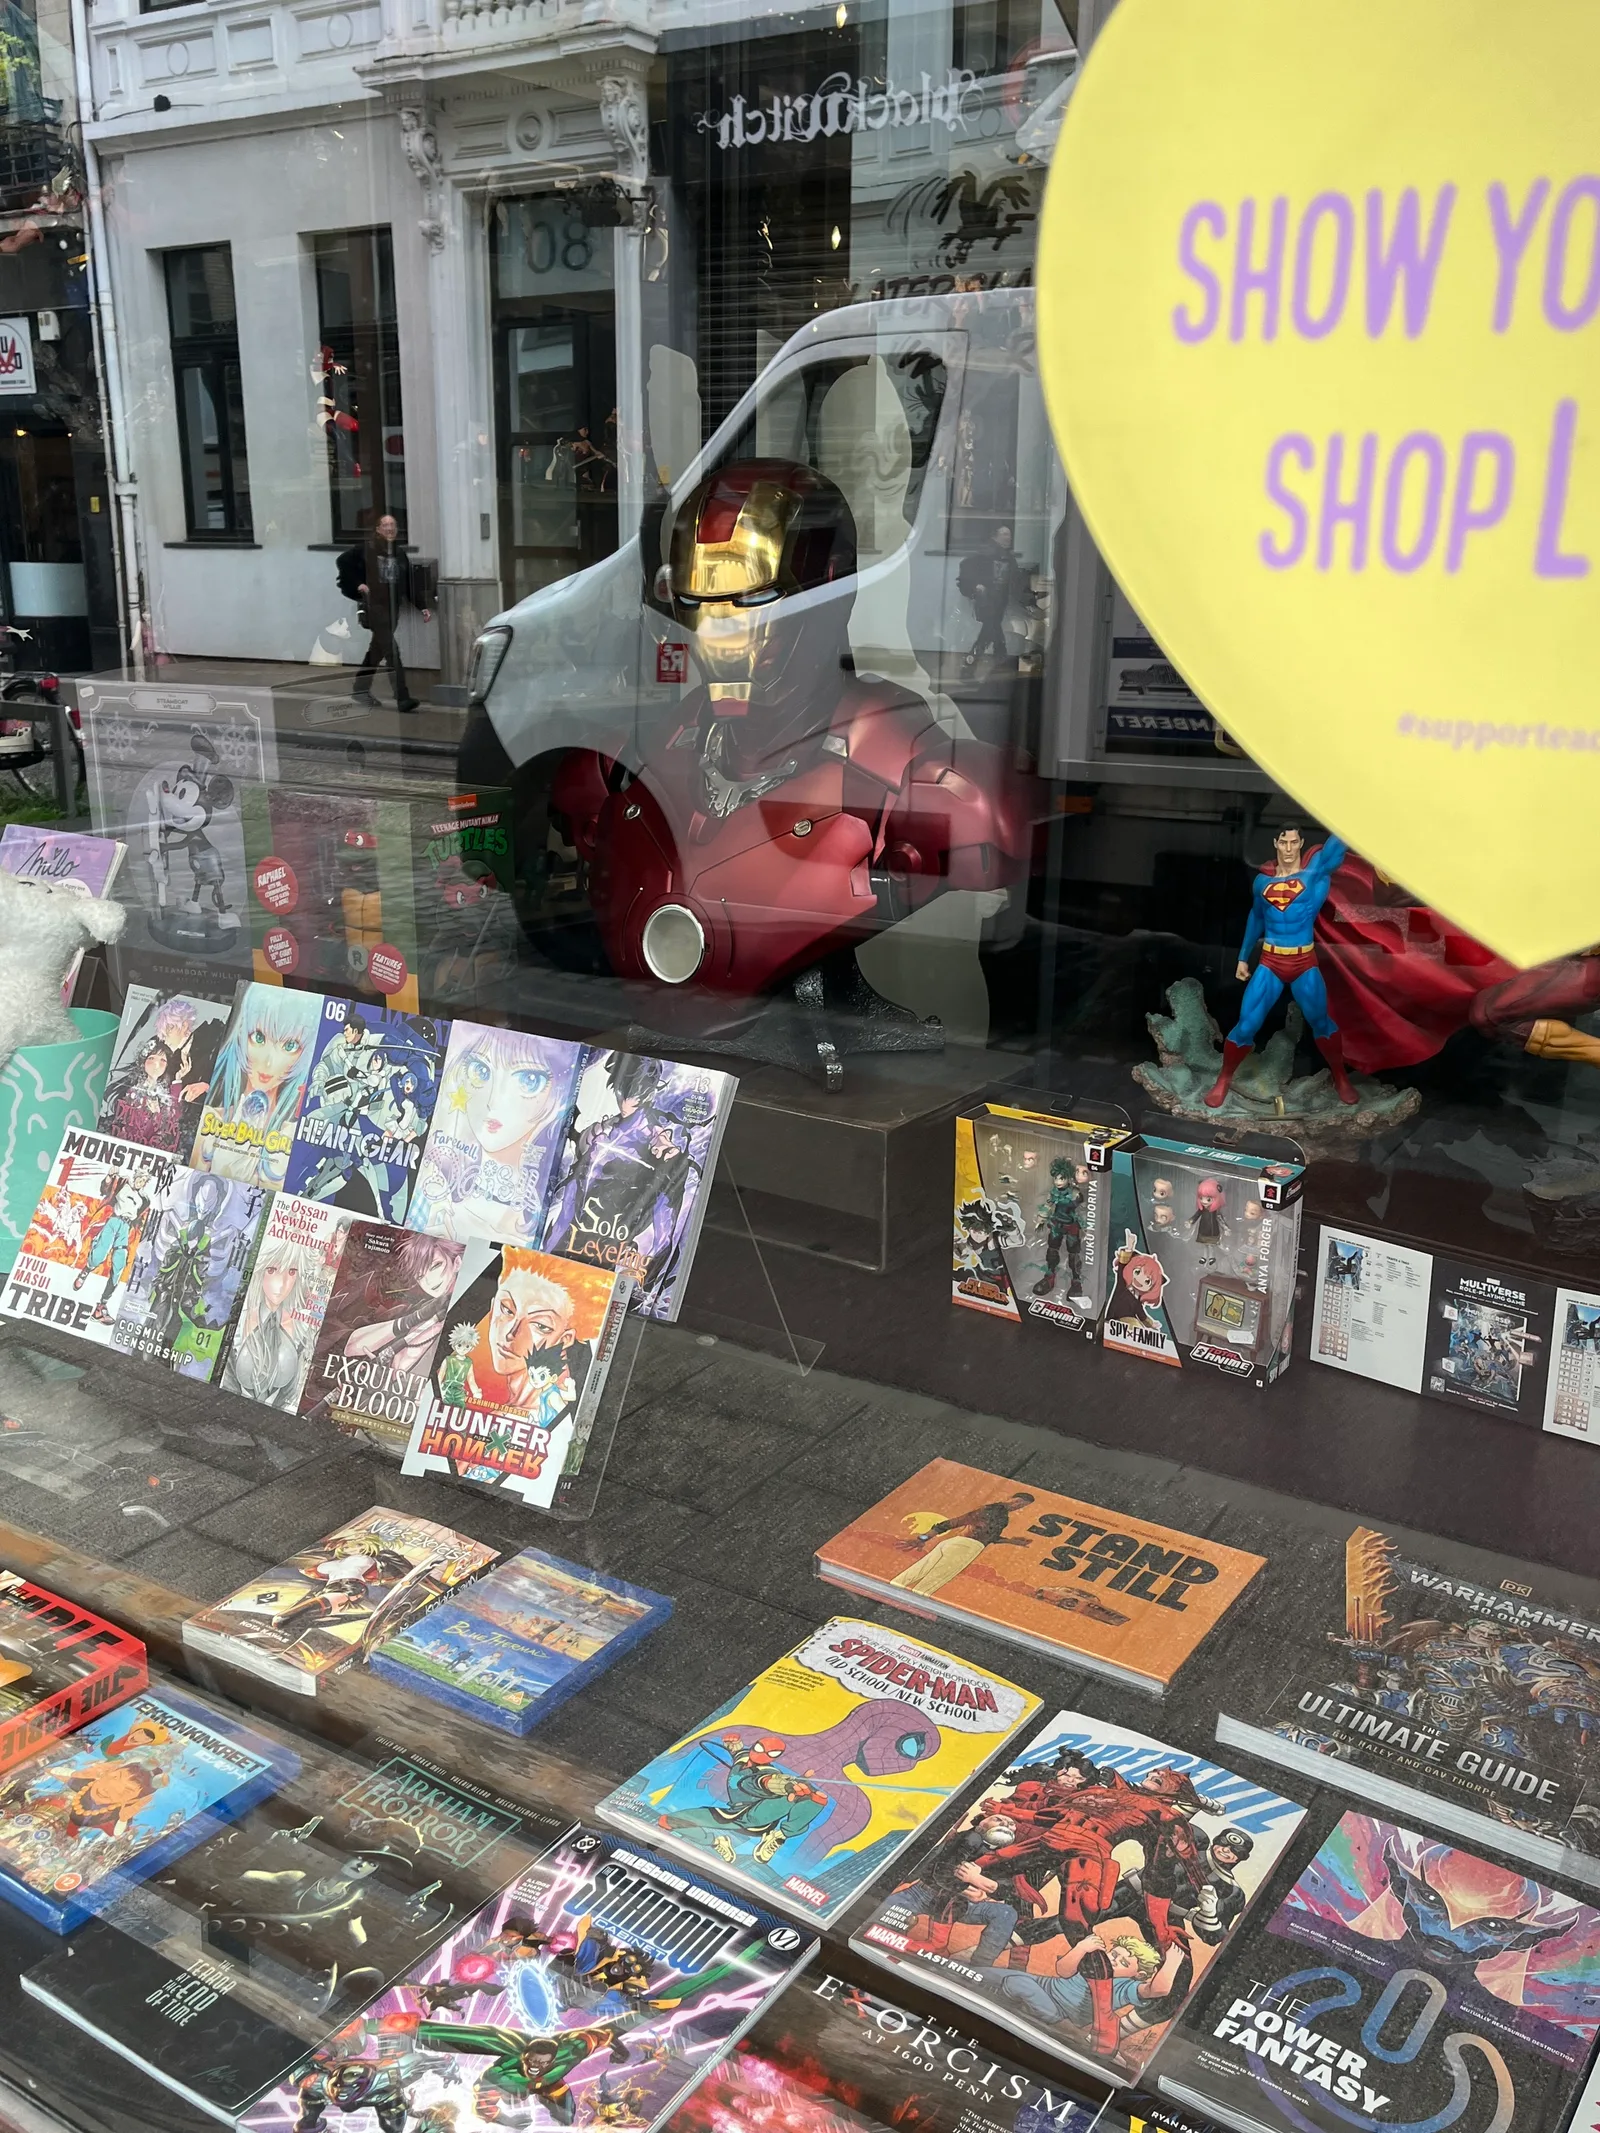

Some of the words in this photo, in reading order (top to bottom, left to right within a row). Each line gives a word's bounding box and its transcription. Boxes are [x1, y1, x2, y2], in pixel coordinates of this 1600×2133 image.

[1172, 181, 1457, 345] SHOW
[1486, 174, 1600, 335] YO
[1258, 431, 1515, 574] SHOP
[1533, 396, 1591, 578] L
[431, 820, 460, 834] TEENAGE
[459, 817, 482, 829] MUTANT
[420, 827, 509, 871] TURTLES
[257, 866, 287, 888] RAPHAEL
[372, 952, 402, 970] FEATURES
[325, 1000, 347, 1022] 06
[692, 1077, 711, 1094] 13
[201, 1113, 237, 1142] SUPER
[235, 1121, 265, 1148] BALL
[296, 1116, 361, 1154] HEART
[360, 1132, 421, 1170] GEAR
[432, 1129, 479, 1161] Farewell,
[57, 1155, 76, 1187] 1
[62, 1131, 168, 1178] MONSTER
[1185, 1146, 1206, 1156] SPY
[1208, 1148, 1245, 1162] FAMILY
[271, 1209, 319, 1234] Newbie
[276, 1199, 291, 1212] The
[290, 1199, 329, 1222] Ossan
[574, 1196, 630, 1242] Solo
[1086, 1180, 1098, 1232] MIDORIYA
[364, 1243, 391, 1254] Fujimoto
[367, 1238, 390, 1248] Sakura
[567, 1222, 653, 1280] Leveling
[1084, 1233, 1096, 1265] IZUKU
[1260, 1218, 1274, 1257] FORGER
[13, 1269, 51, 1290] MASUI
[18, 1255, 48, 1276] JYUU
[1257, 1260, 1270, 1294] ANYA
[1459, 1285, 1505, 1302] ROLE-PLAYING
[1505, 1297, 1526, 1307] GAME
[1460, 1277, 1526, 1301] MULTIVERSE
[7, 1284, 94, 1332] TRIBE
[1041, 1308, 1082, 1325] ANIME
[118, 1319, 165, 1344] COSMIC
[195, 1331, 212, 1350] 01
[602, 1301, 627, 1363] HUNTER
[114, 1332, 193, 1366] CENSORSHIP
[1204, 1353, 1250, 1371] ANIME
[1207, 1346, 1241, 1360] TOTAL
[336, 1383, 417, 1425] BLOOD
[464, 1395, 499, 1410] YOSHIHIRO
[499, 1403, 530, 1417] TOGASHI
[427, 1399, 551, 1457] HUNTER
[1027, 1513, 1220, 1585] STAND
[1039, 1545, 1189, 1612] STILL
[1503, 1580, 1530, 1596] DK
[262, 1592, 277, 1603] 2
[1409, 1569, 1600, 1642] WARHAMMER
[239, 1620, 262, 1633] KOTA
[260, 1626, 290, 1645] KAWAE
[829, 1638, 999, 1713] SPIDER-MAN
[858, 1634, 879, 1649] YOUR
[878, 1643, 918, 1667] FRIENDLY
[917, 1661, 990, 1689] NEIGHBORHOOD
[920, 1653, 950, 1670] ANIMATION
[825, 1654, 848, 1670] OLD
[926, 1699, 981, 1722] SCHOOL
[128, 1697, 266, 1774] TEKKONKINKREET
[1298, 1690, 1451, 1763] ULTIMATE
[1455, 1749, 1560, 1805] GUIDE
[1421, 1724, 1443, 1738] THE
[1331, 1730, 1355, 1746] GUY
[1358, 1740, 1394, 1758] HALEY
[1396, 1754, 1421, 1770] AND
[1424, 1764, 1448, 1780] GAV
[1451, 1774, 1498, 1799] THORPE
[388, 1769, 497, 1832] ARKHAM
[357, 1782, 478, 1856] HORROR
[578, 1837, 595, 1849] DC
[785, 1876, 829, 1906] MARVEL
[880, 1915, 909, 1931] ABURTOV
[885, 1910, 907, 1923] KUDER
[890, 1904, 913, 1917] AHMED
[594, 1917, 668, 1961] CABINET
[866, 1926, 911, 1952] MARVEL
[186, 1958, 238, 1996] TERROR
[917, 1948, 948, 1967] LAST
[947, 1961, 984, 1983] RITES
[145, 1989, 171, 2007] OF
[160, 1998, 198, 2027] TIME
[175, 1980, 219, 2012] END
[1246, 1979, 1311, 2022] THE
[926, 2014, 980, 2049] THE
[1226, 1998, 1368, 2080] POWER
[1460, 2005, 1491, 2023] MUTUALLY
[1491, 2020, 1532, 2042] REASSURING
[1531, 2038, 1575, 2063] DESTRUCTION
[812, 1974, 1076, 2125] EXORCISM
[861, 2029, 886, 2045] AT
[891, 2044, 936, 2073] 1600
[942, 2071, 996, 2104] PENN
[1212, 2017, 1391, 2115] FANTASY
[1150, 2110, 1179, 2129] RYAN
